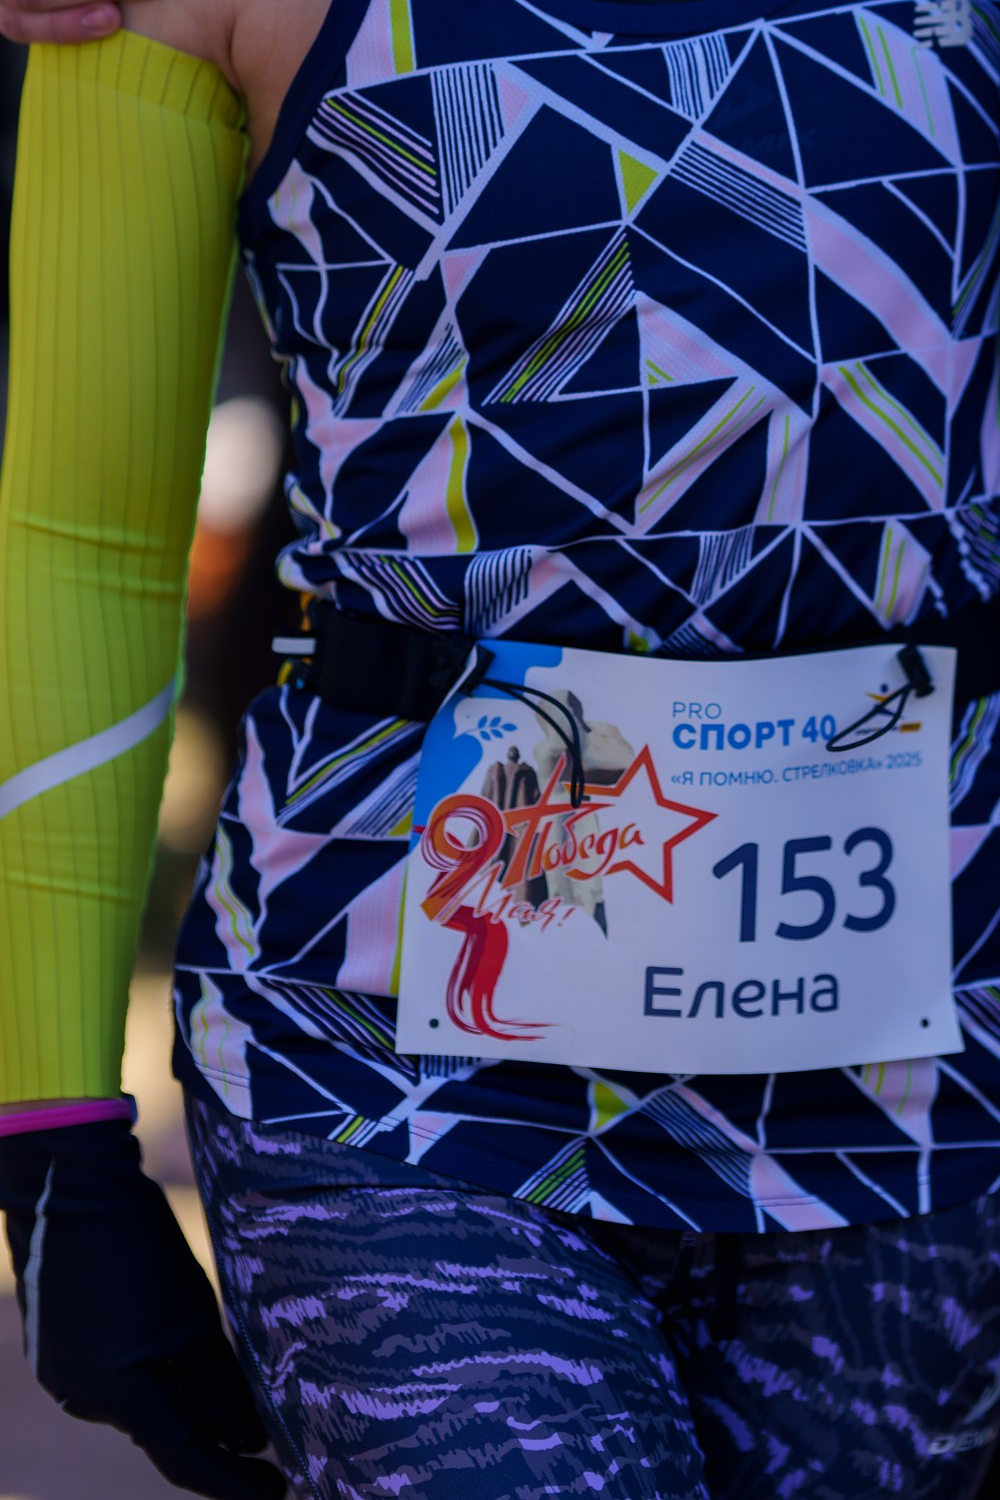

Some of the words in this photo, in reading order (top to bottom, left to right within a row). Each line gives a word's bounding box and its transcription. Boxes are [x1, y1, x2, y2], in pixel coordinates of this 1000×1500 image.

[672, 702, 722, 719] PRO
[672, 719, 795, 751] СПОРТ
[802, 714, 837, 742] 40
[713, 827, 896, 942] 153
[643, 966, 839, 1019] Елена
